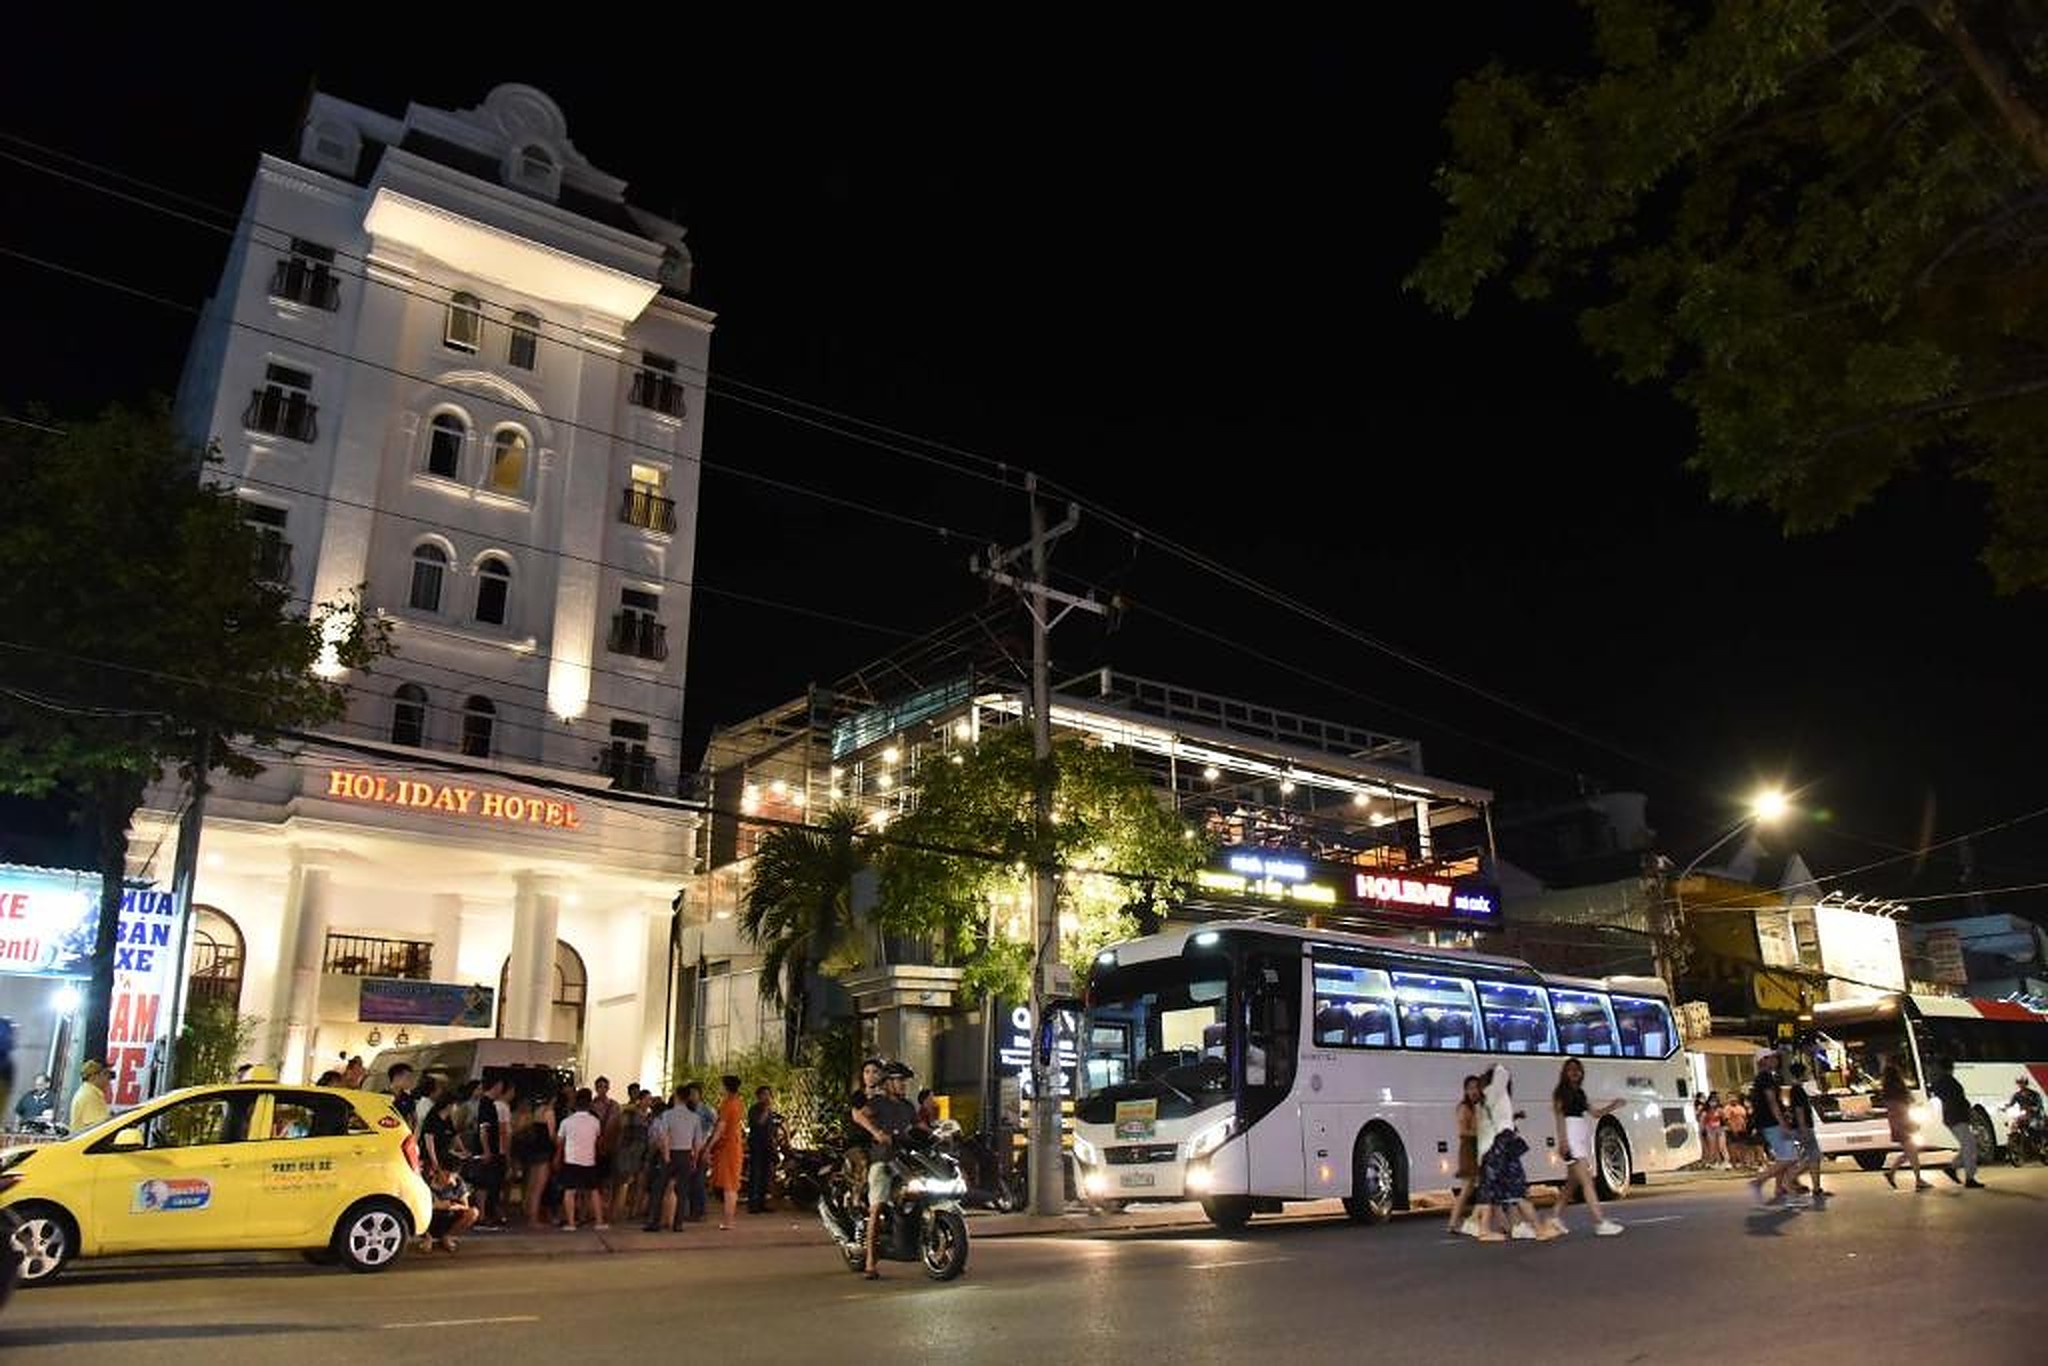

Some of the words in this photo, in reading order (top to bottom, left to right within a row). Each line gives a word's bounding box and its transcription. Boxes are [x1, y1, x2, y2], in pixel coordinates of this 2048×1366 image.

[328, 770, 475, 814] HOLIDAY
[480, 793, 582, 829] HOTEL
[1356, 874, 1452, 907] HOLIDAY
[114, 947, 154, 972] XE
